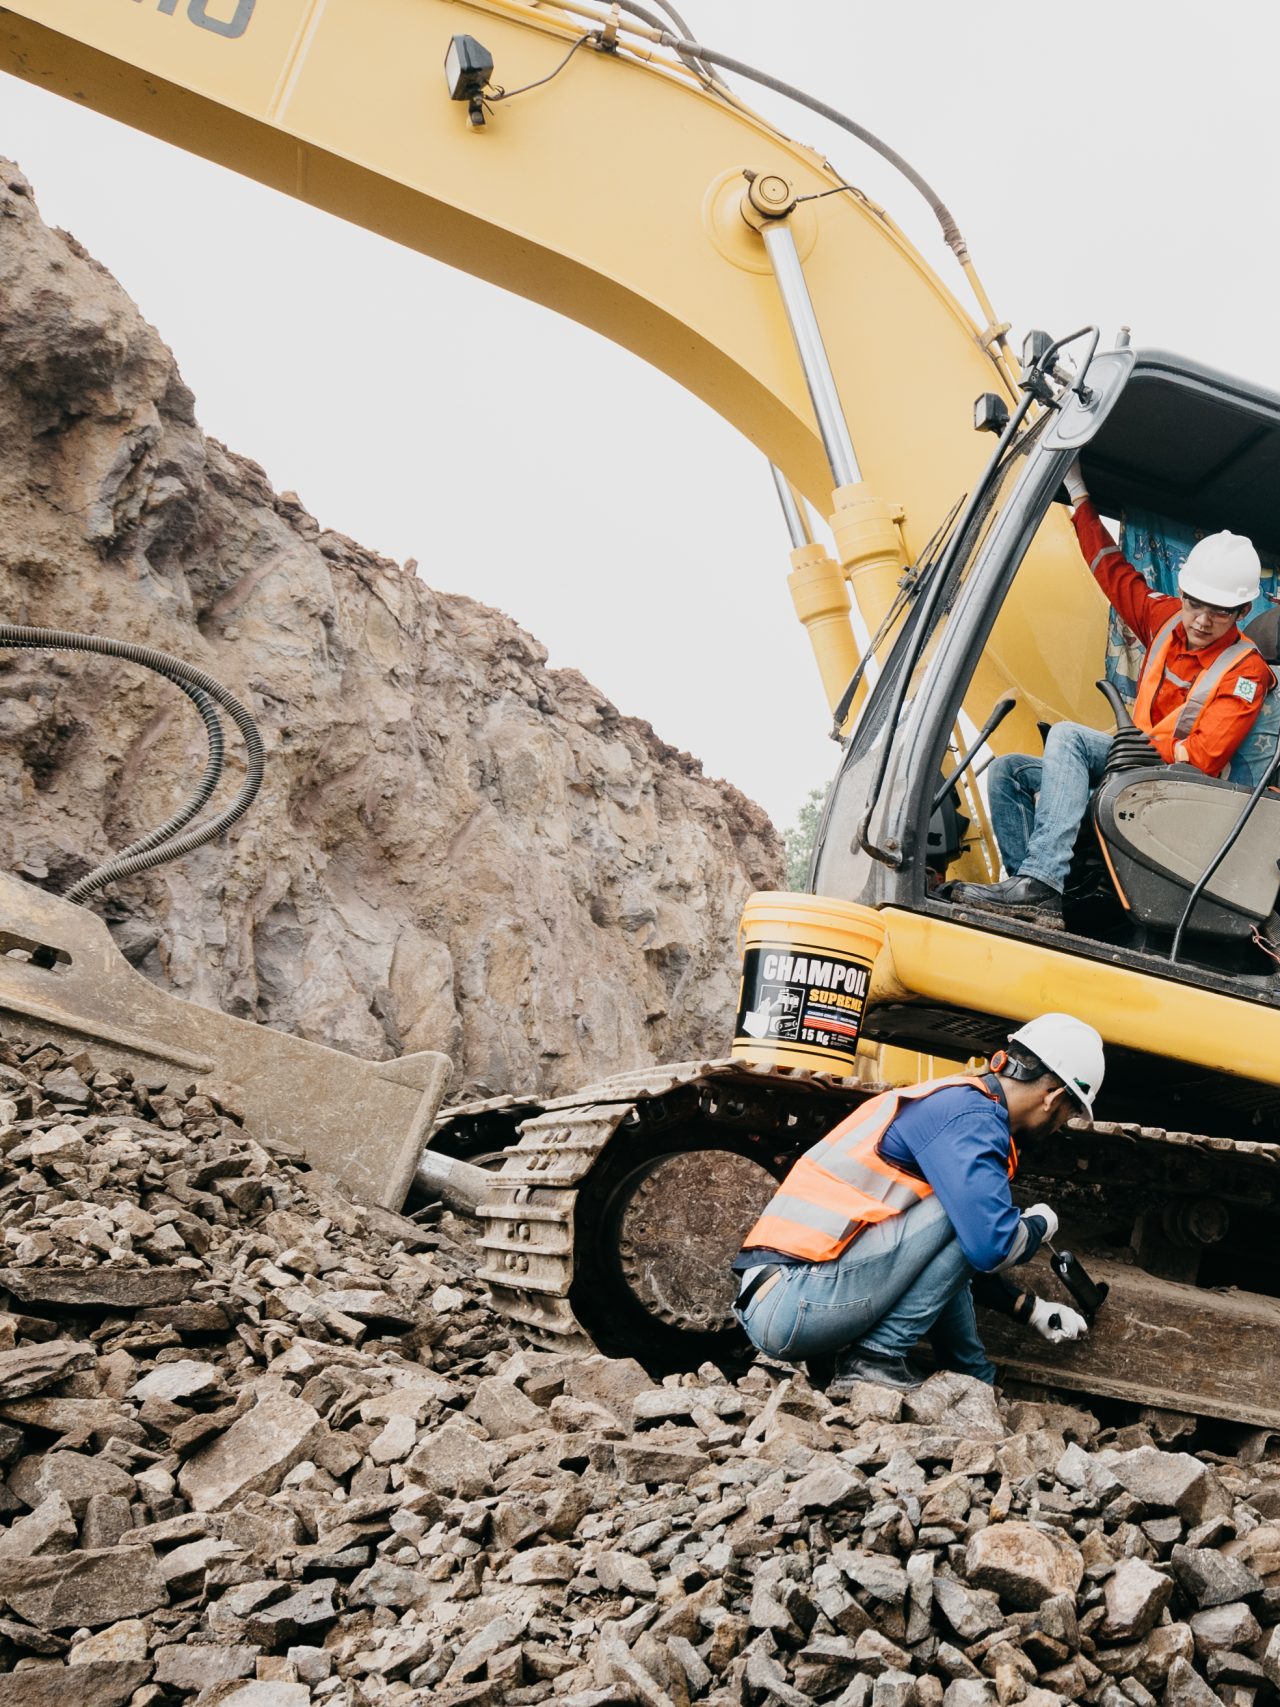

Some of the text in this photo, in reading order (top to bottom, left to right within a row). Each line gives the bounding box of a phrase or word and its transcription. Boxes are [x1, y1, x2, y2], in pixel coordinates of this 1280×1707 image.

[763, 954, 867, 997] CHAMPOIL
[809, 988, 863, 1012] SUPREME
[801, 1028, 815, 1041] 15
[816, 1031, 830, 1046] Kg
